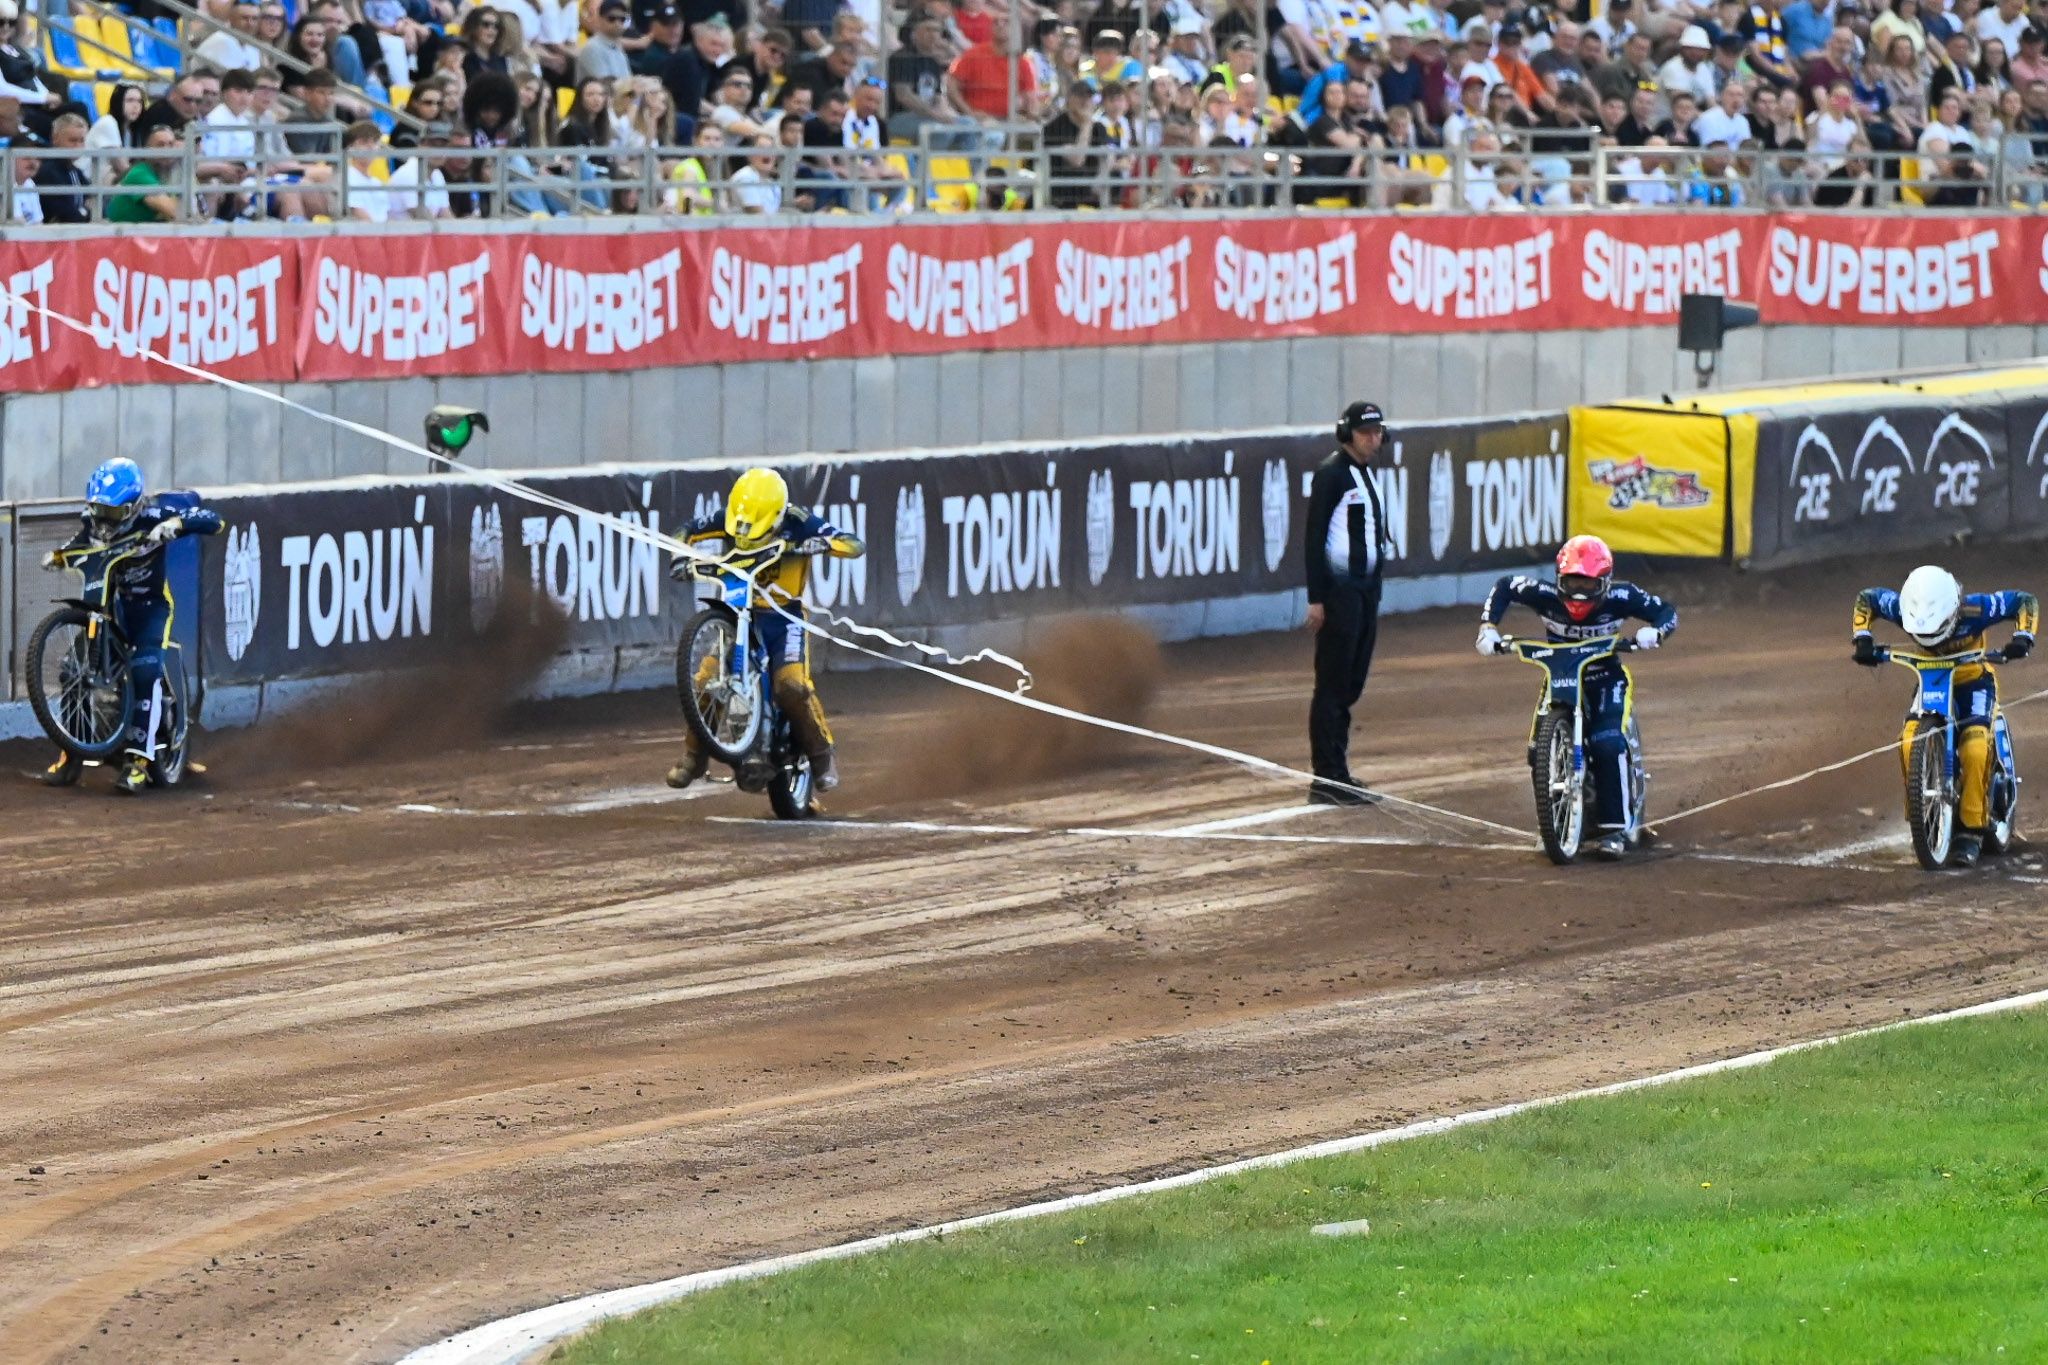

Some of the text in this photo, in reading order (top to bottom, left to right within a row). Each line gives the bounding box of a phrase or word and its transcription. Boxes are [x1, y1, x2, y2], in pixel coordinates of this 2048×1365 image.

[92, 253, 283, 366] SUPERBET
[315, 252, 490, 361] SUPERBET
[522, 248, 681, 354] SUPERBET
[709, 243, 862, 344] SUPERBET
[886, 237, 1033, 337] SUPERBET
[1055, 236, 1191, 330] SUPERBET
[1214, 231, 1356, 324] SUPERBET
[1388, 231, 1553, 319] SUPERBET
[1582, 228, 1743, 314] SUPERBET
[1769, 227, 1999, 314] SUPERBET
[942, 475, 1061, 598] TORUŃ
[1130, 450, 1240, 579] TORUŃ
[1466, 429, 1565, 552] TORUŃ
[281, 495, 434, 650] TORUŃ
[521, 480, 660, 623] TORUŃ
